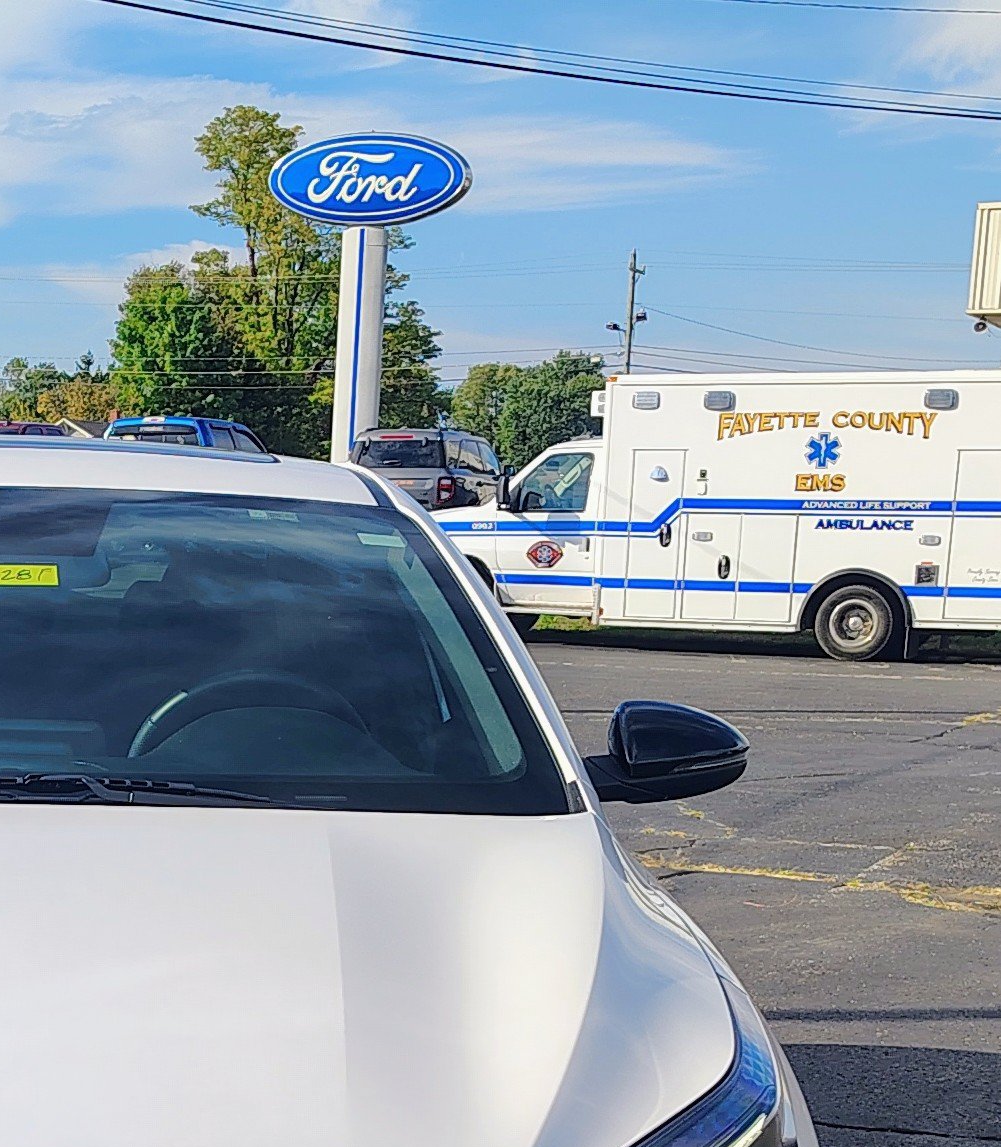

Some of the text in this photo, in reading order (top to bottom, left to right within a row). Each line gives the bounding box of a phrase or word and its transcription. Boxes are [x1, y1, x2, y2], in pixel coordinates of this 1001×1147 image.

[307, 151, 423, 204] Ford
[716, 411, 938, 441] FAYETTE COUNTY
[795, 473, 846, 492] EMS
[802, 501, 931, 510] ADVANCED LIFE SUPPORT
[814, 518, 915, 531] AMBULANCE
